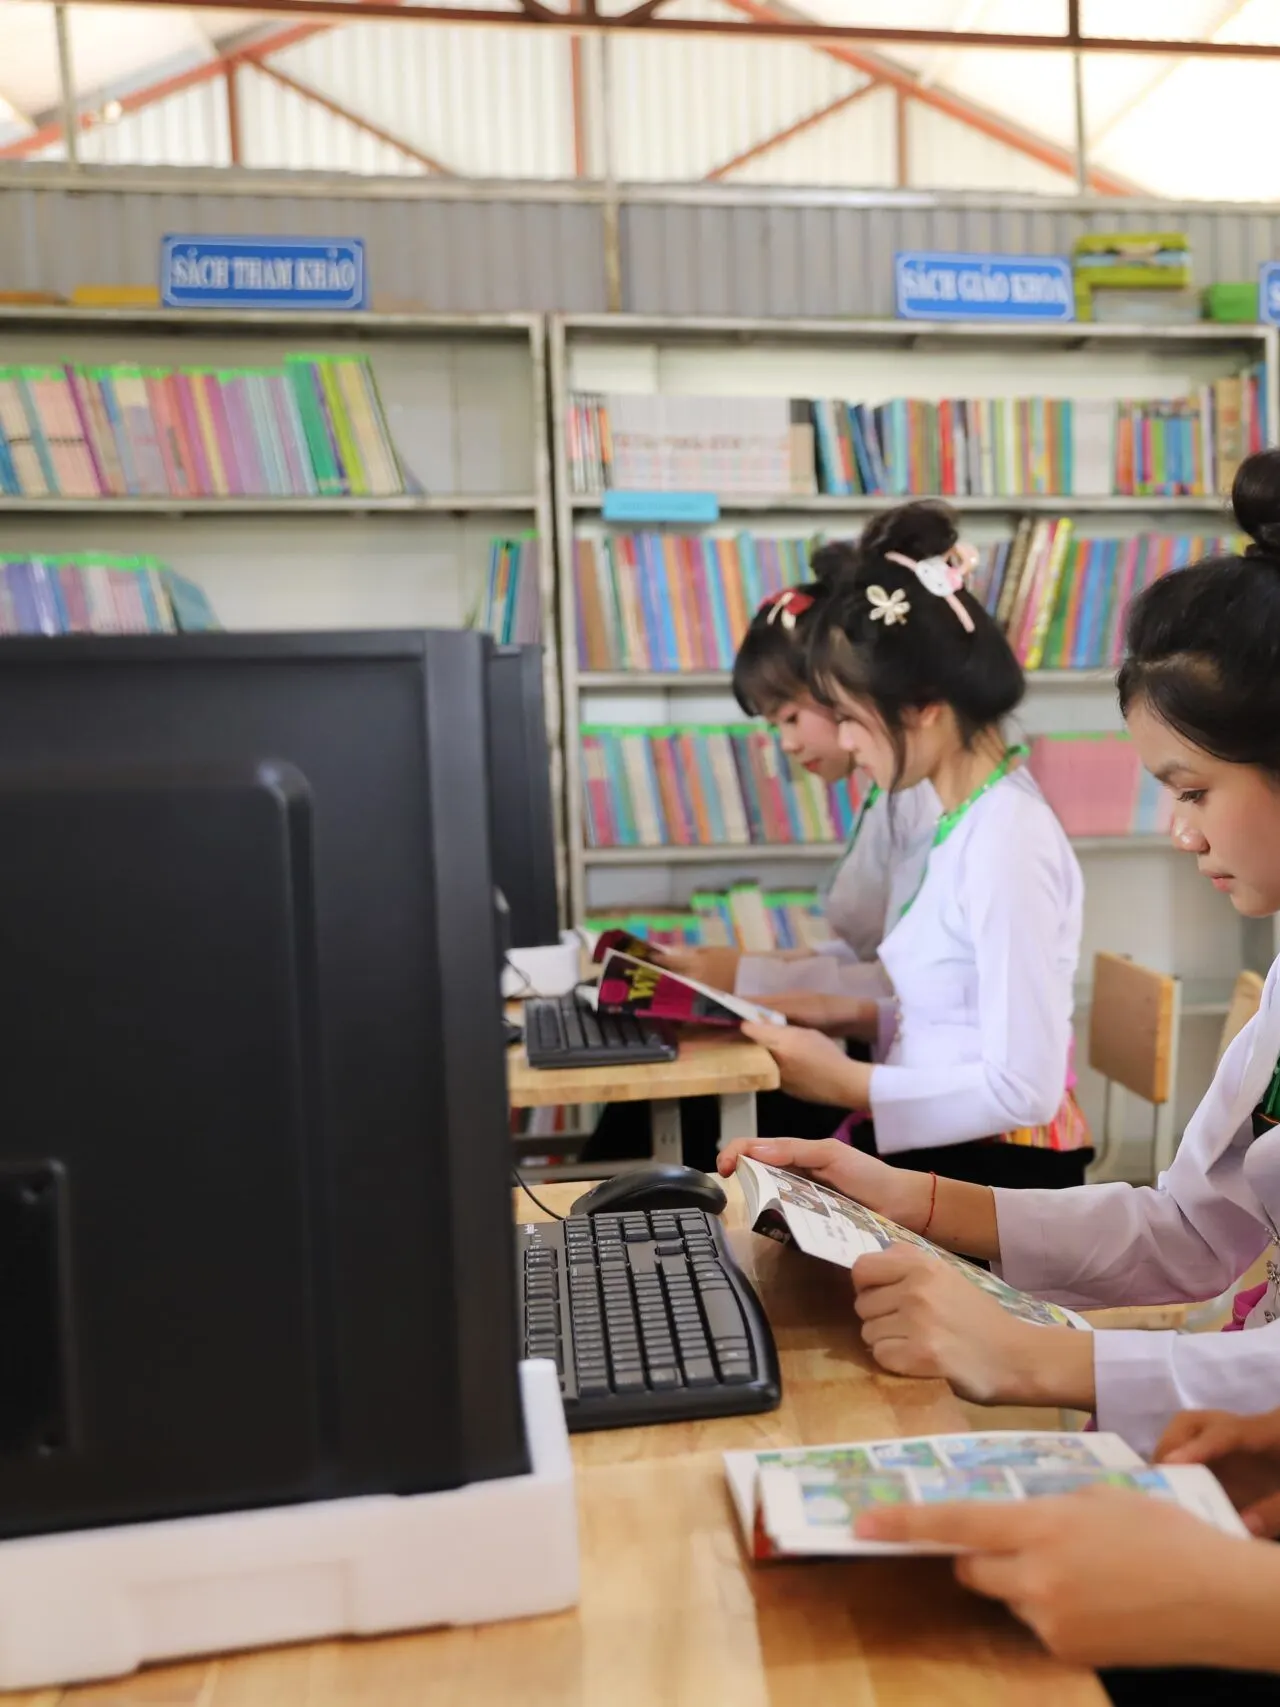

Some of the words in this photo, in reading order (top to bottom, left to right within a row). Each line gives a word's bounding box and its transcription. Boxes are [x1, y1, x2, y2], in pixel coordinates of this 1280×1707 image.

[171, 246, 229, 289] SÁCH
[232, 257, 293, 290] THAM
[295, 247, 355, 291] KHẢO
[901, 262, 957, 300] SÁCH
